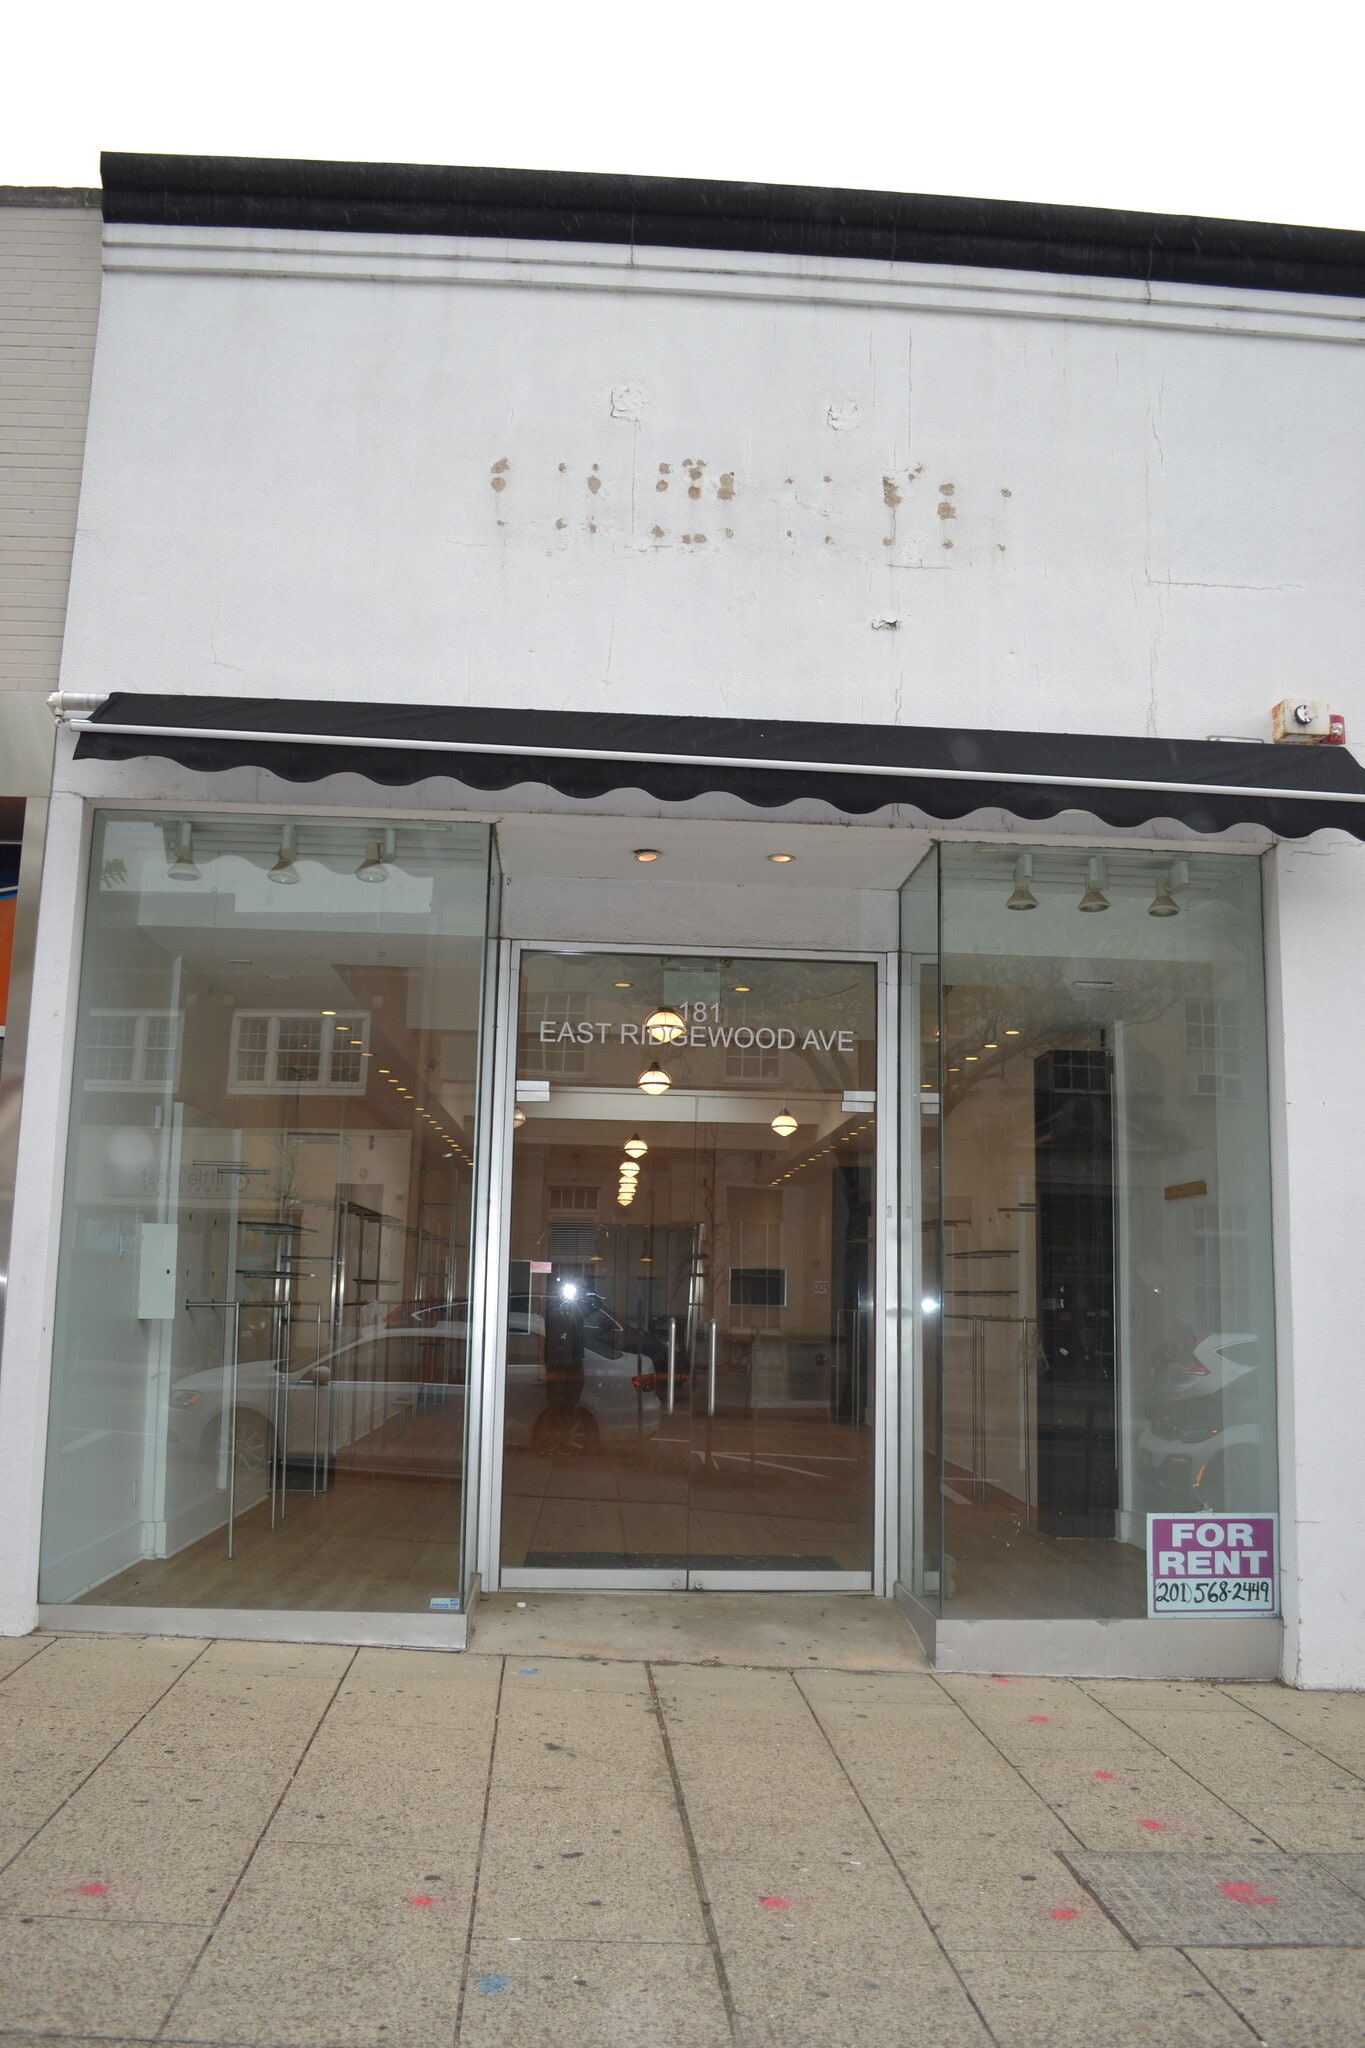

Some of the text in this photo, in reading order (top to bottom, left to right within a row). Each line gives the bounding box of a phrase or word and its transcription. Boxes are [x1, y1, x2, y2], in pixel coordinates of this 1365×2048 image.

[679, 1001, 720, 1023] 181
[540, 1021, 854, 1052] EAST RIDGEWOOD AVE
[1172, 1523, 1254, 1548] FOR
[1159, 1551, 1268, 1575] RENT
